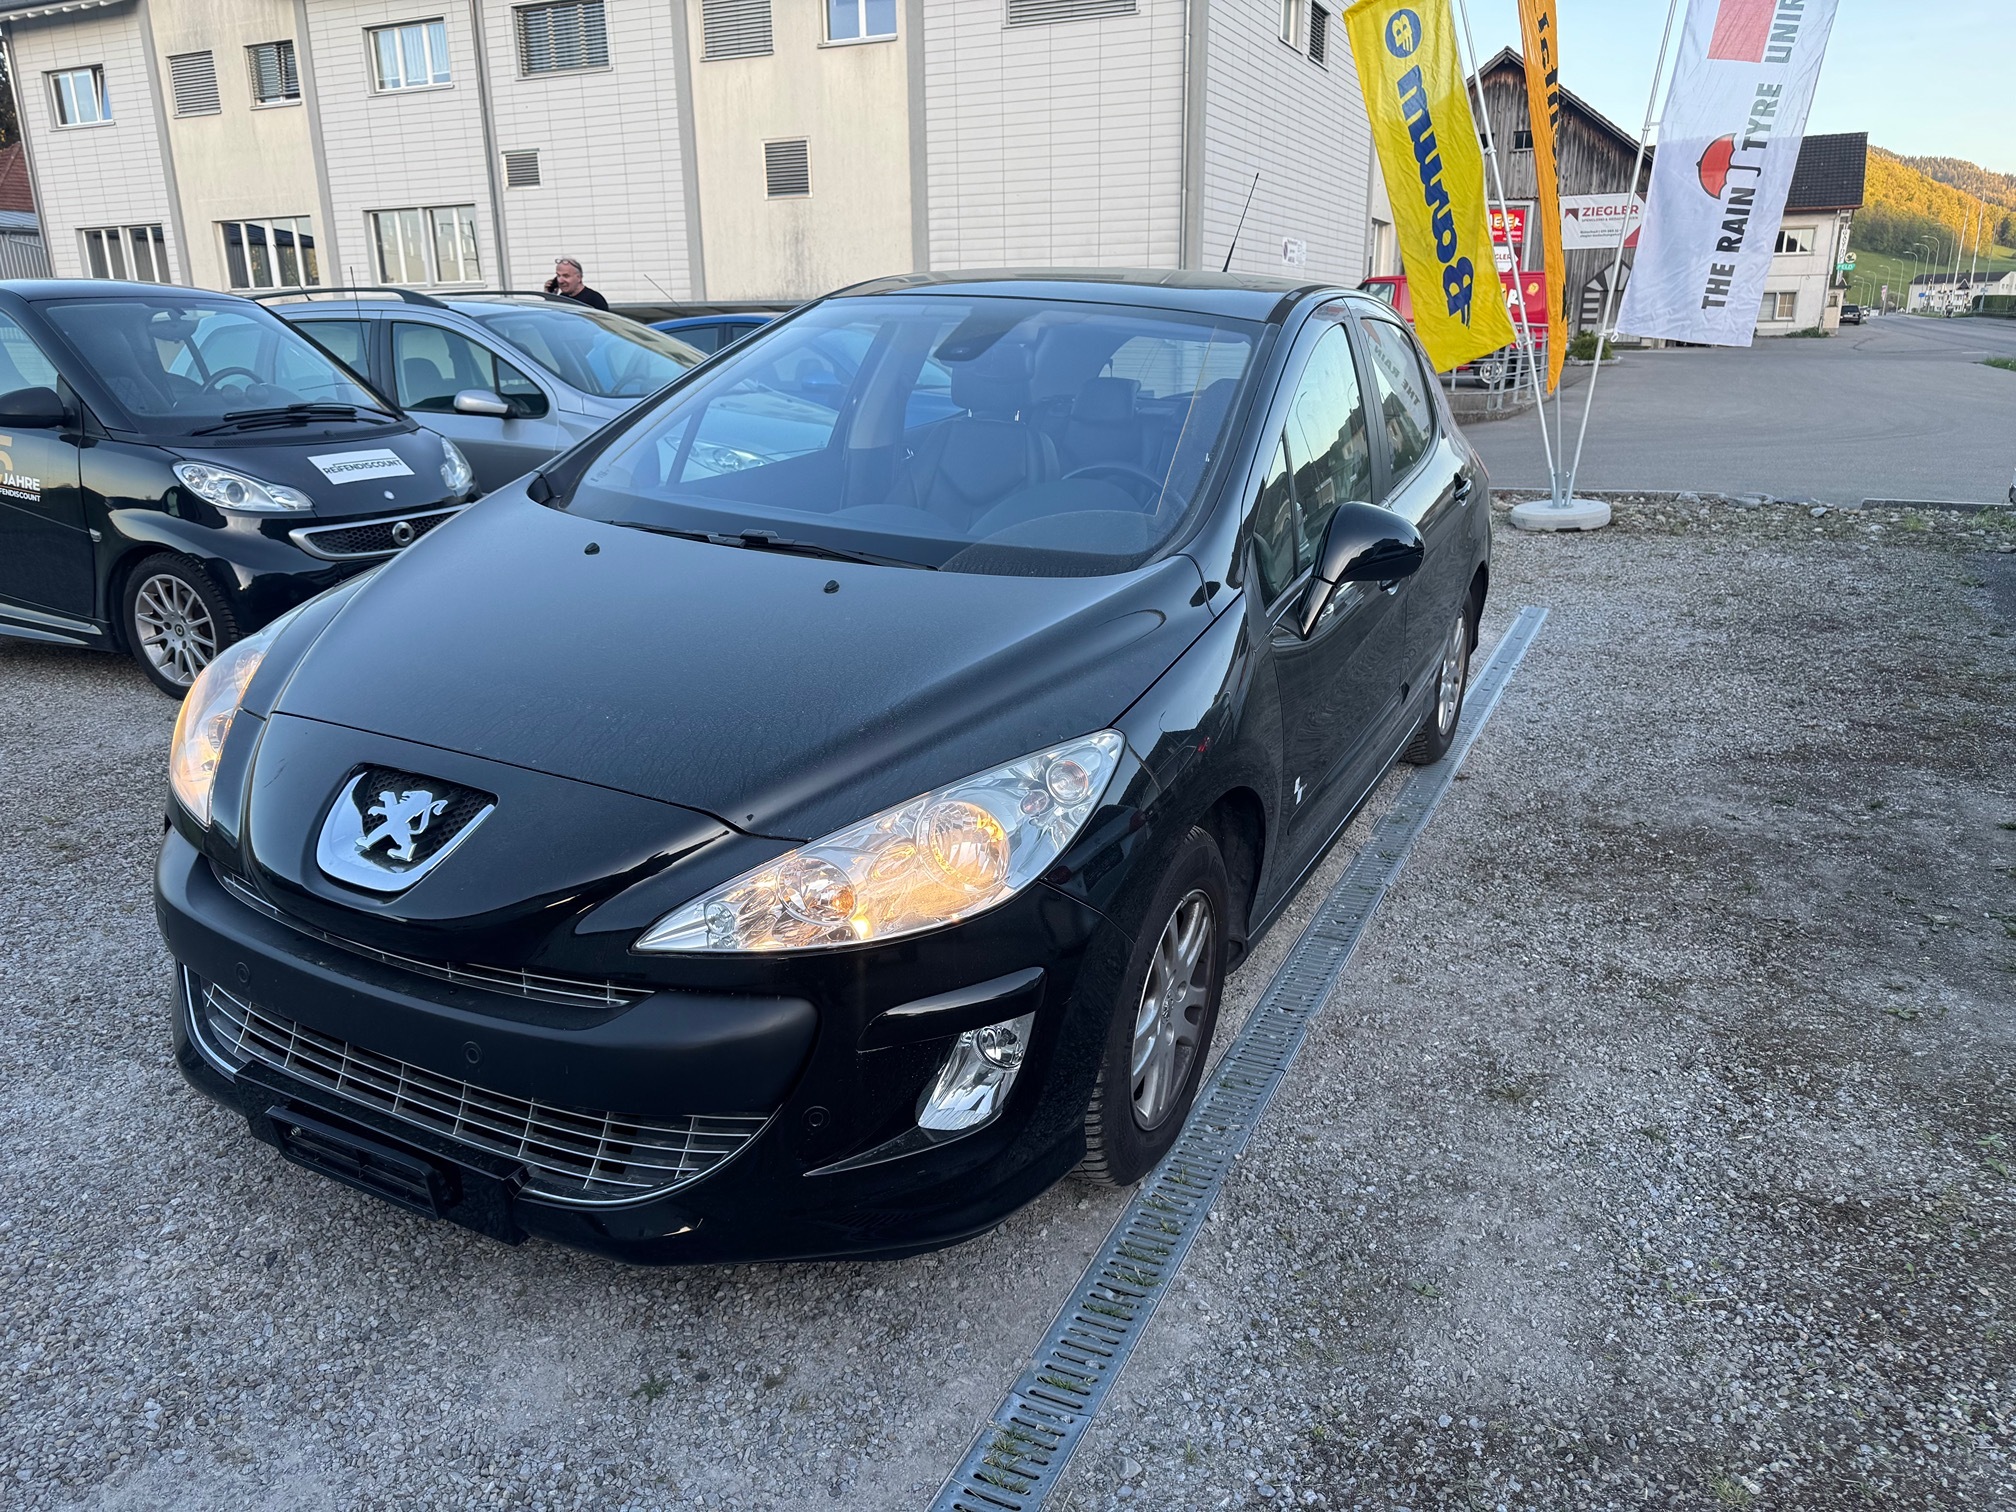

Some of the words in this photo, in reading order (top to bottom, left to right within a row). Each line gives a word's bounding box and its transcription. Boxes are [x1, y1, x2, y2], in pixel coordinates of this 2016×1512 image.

[1741, 83, 1783, 151] TYRE
[1397, 64, 1474, 329] Barum
[1582, 205, 1639, 217] ZIEGLER
[1715, 187, 1756, 253] RAIN
[1701, 263, 1735, 310] THE
[3, 472, 41, 491] JAHRE
[322, 460, 402, 474] REIFENDISCOUNT
